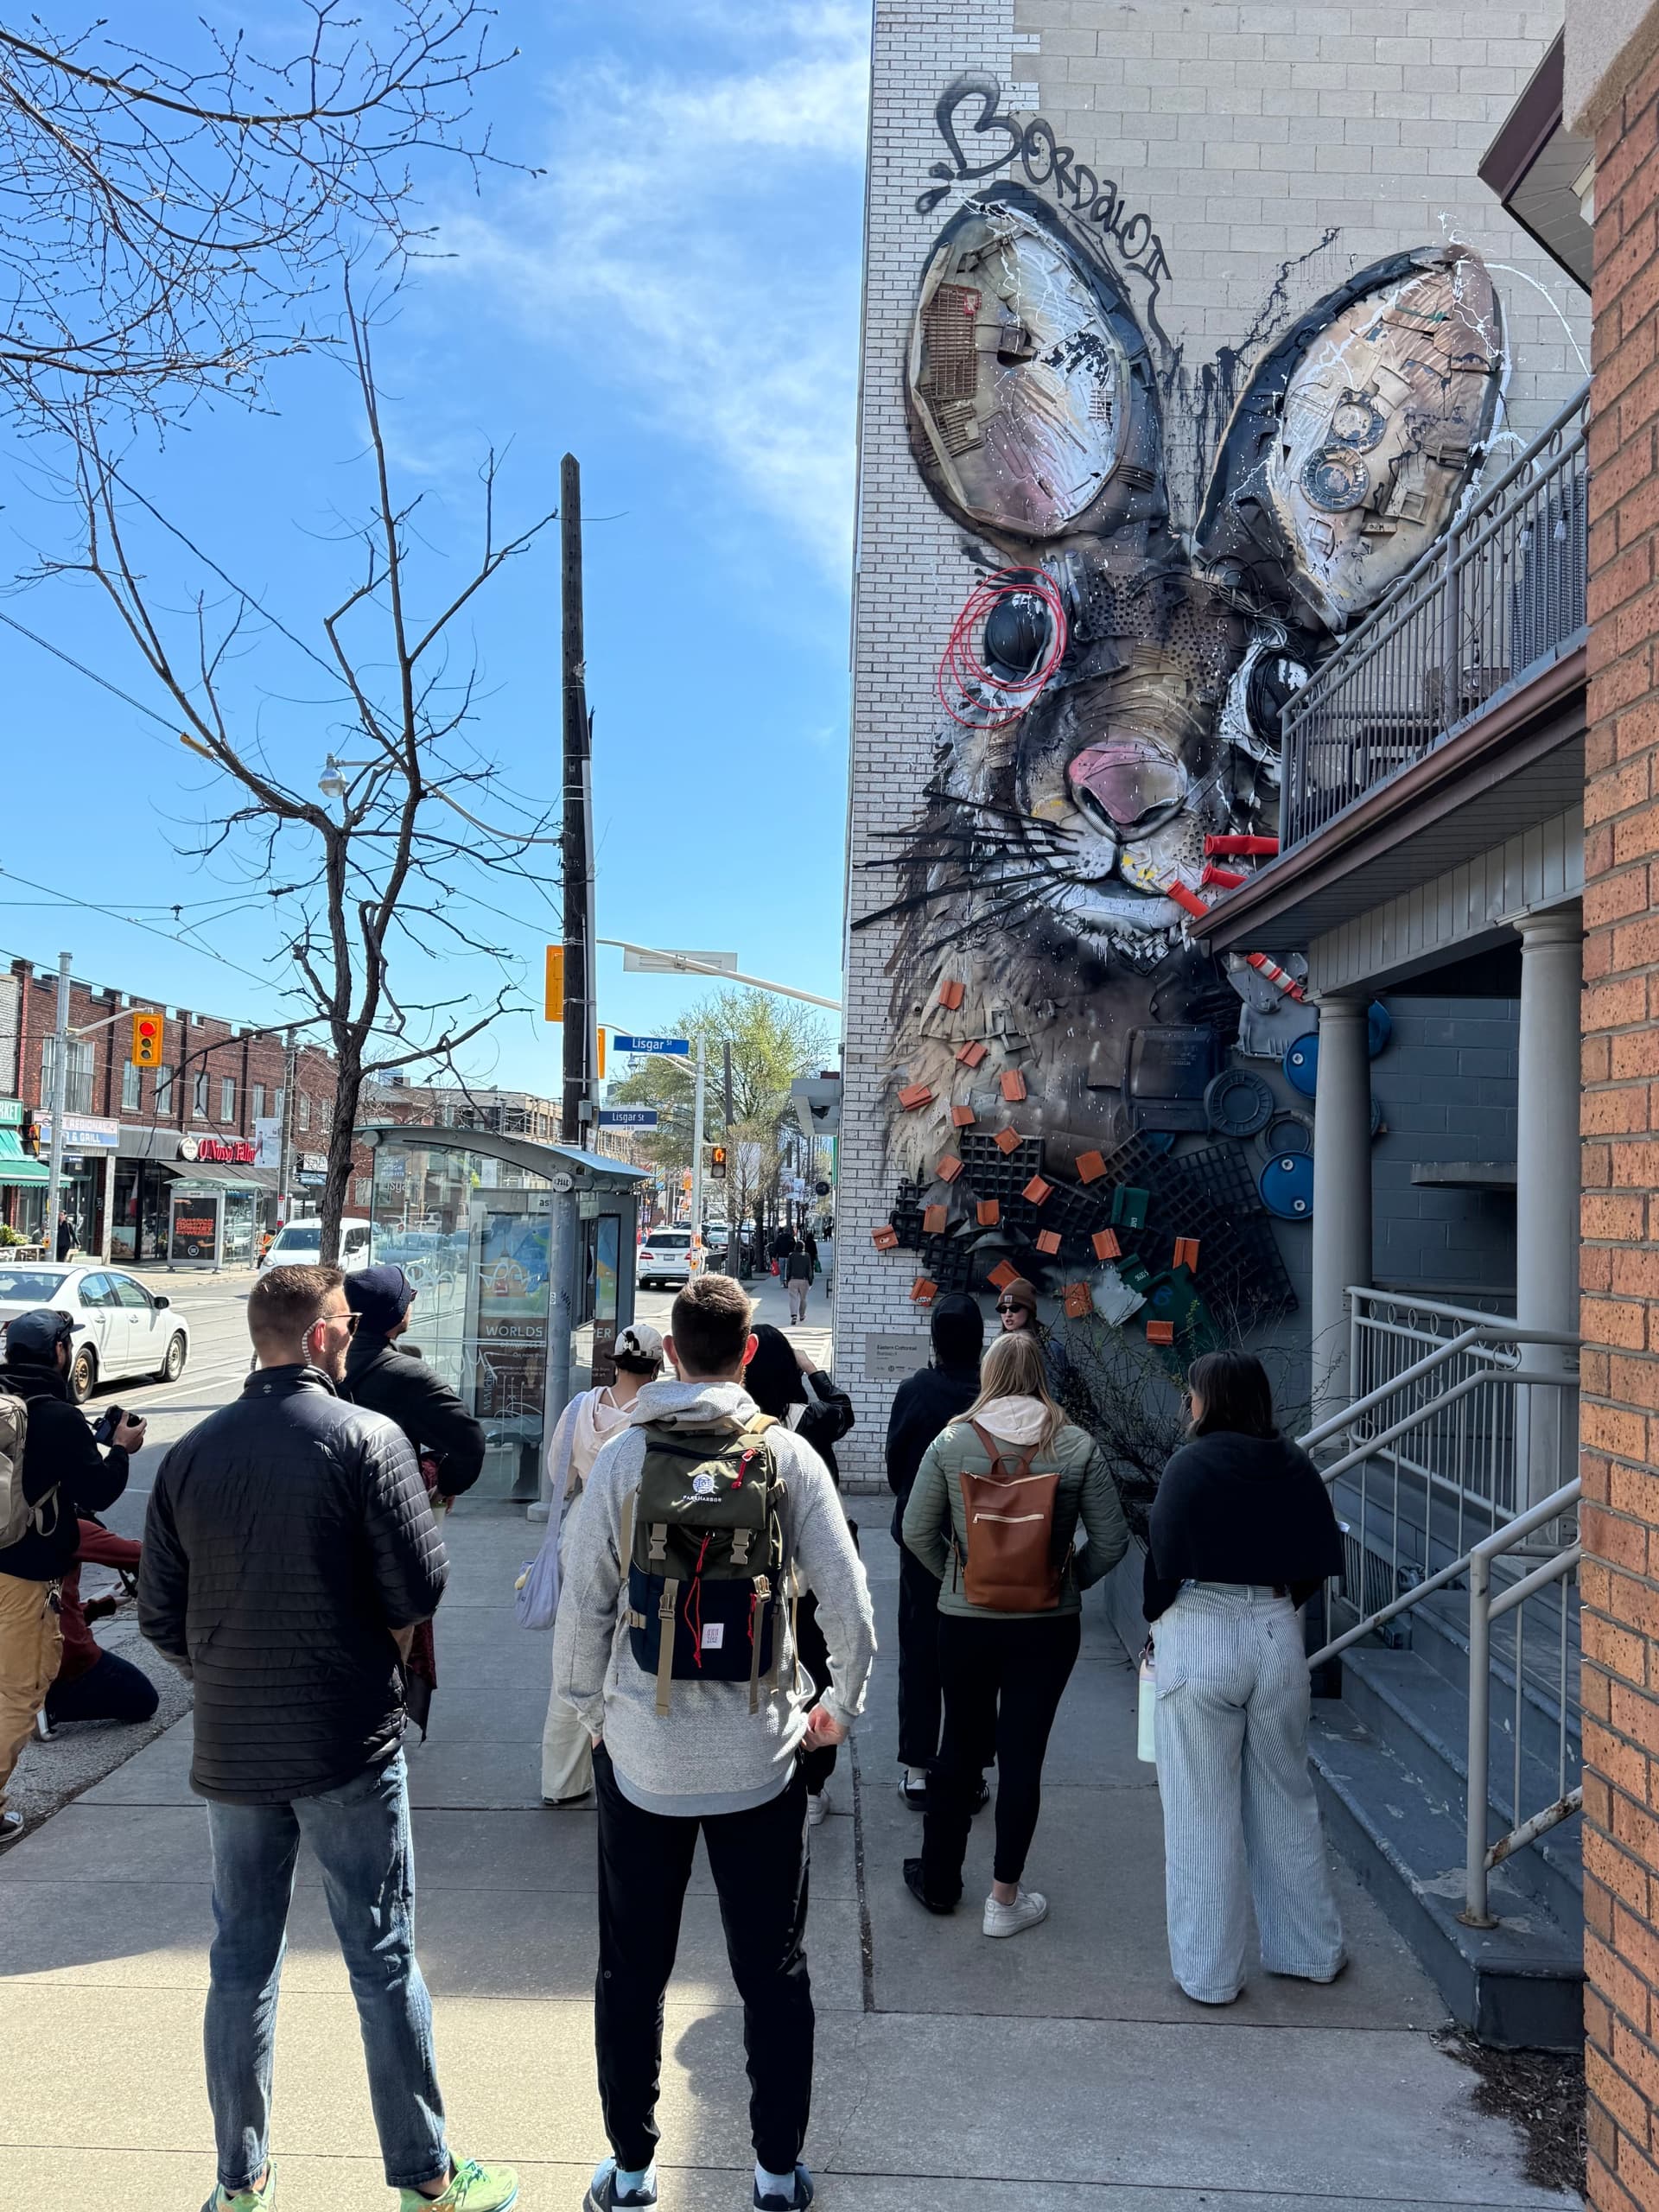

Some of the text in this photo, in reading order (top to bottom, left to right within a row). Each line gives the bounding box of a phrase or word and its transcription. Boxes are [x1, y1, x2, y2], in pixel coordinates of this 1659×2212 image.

[632, 1037, 664, 1052] Lisgar
[612, 1112, 637, 1123] Lisgar
[79, 1132, 101, 1143] GRILL
[486, 1325, 612, 1338] WORLDS ER
